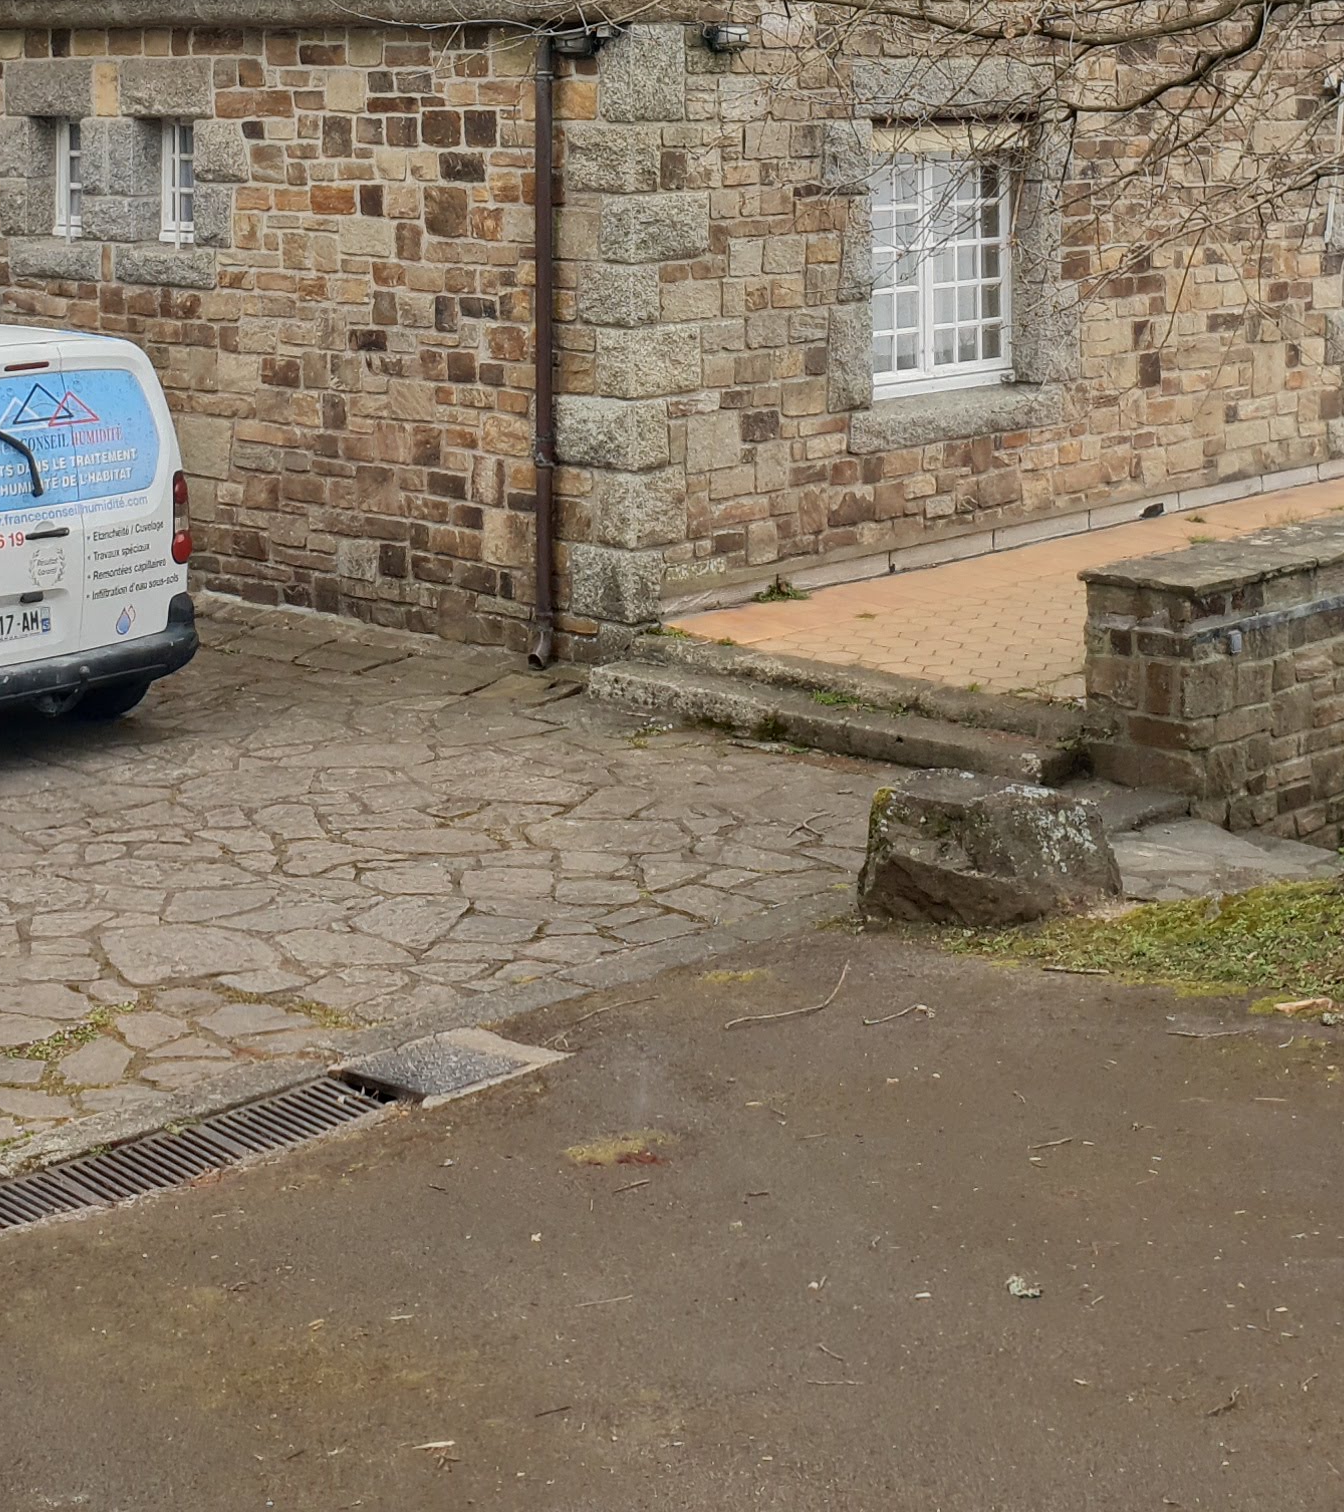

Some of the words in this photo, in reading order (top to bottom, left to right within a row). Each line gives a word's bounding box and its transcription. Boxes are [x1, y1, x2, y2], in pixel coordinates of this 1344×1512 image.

[21, 433, 70, 452] ONSEIL
[71, 424, 123, 446] HUMIDITÉ
[52, 457, 68, 471] LE
[70, 448, 137, 468] TRAITEMENT
[62, 476, 78, 489] DE
[79, 468, 133, 487] L'HABITAT
[8, 532, 25, 547] 19
[93, 550, 120, 561] Travaux
